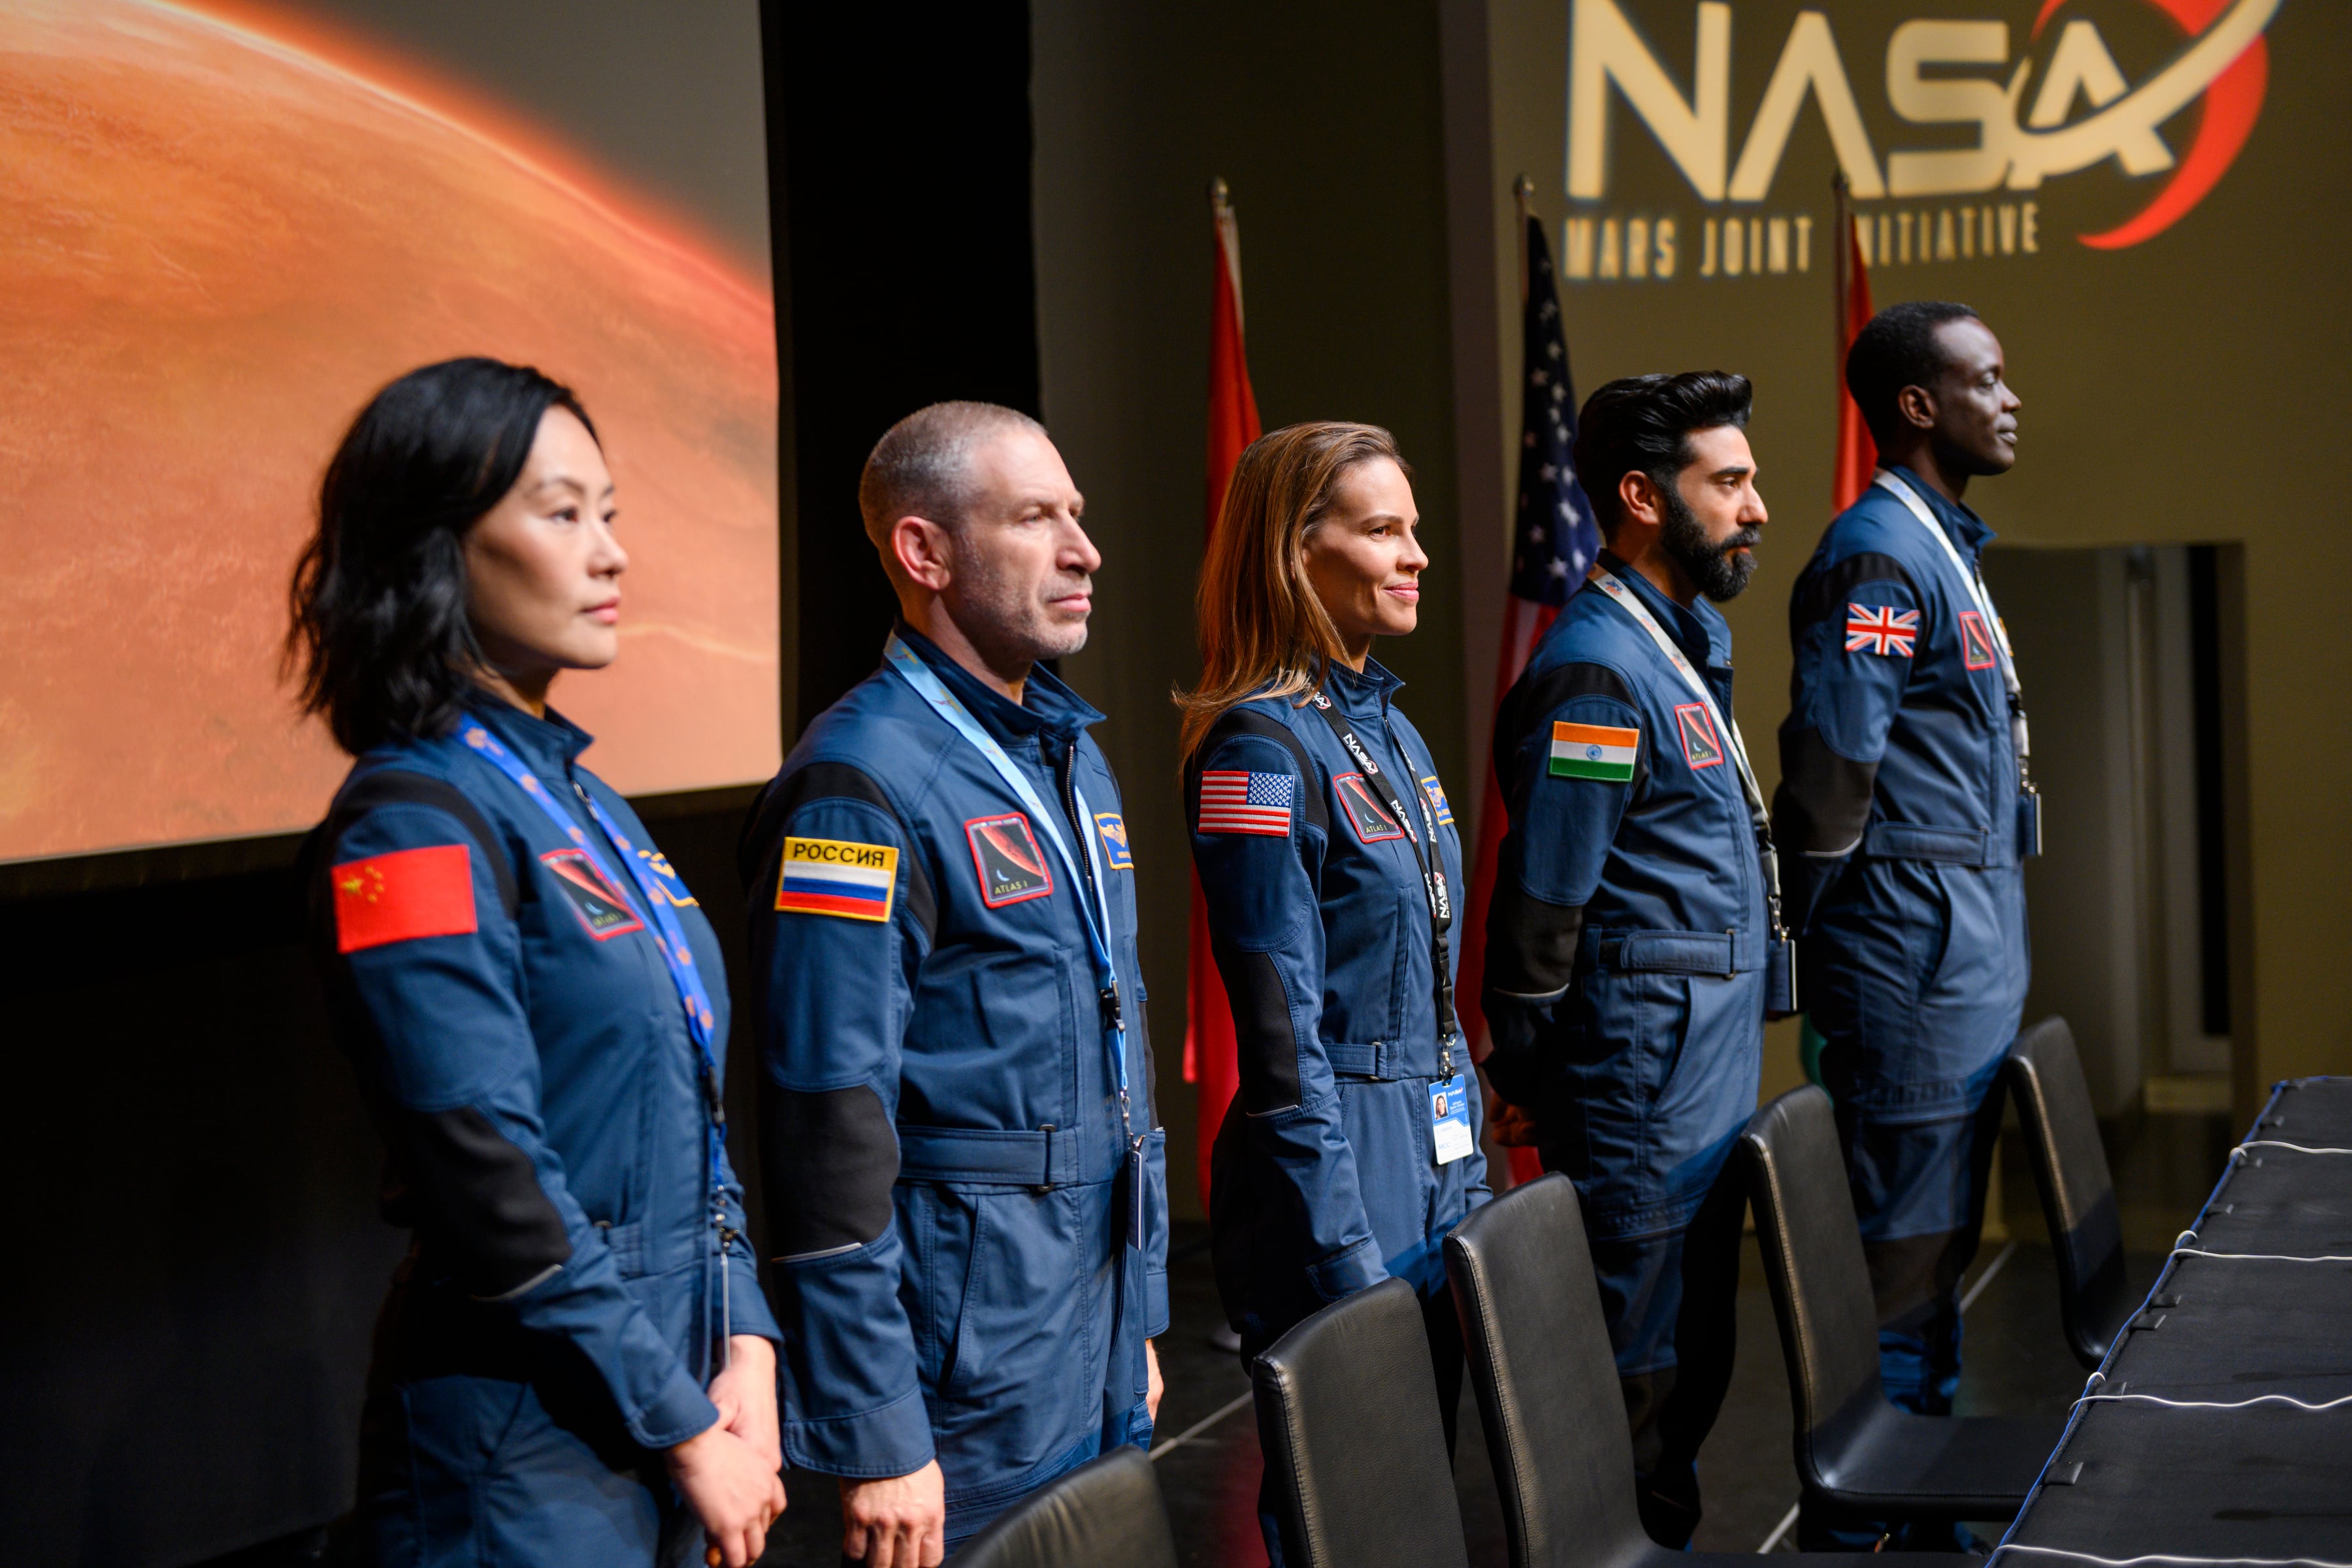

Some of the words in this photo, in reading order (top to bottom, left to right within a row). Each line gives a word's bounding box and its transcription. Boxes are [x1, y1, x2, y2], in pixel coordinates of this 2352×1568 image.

[1566, 0, 2177, 201] NASA
[1563, 217, 1677, 279] MARS
[1700, 216, 1812, 276] JOINT
[1854, 201, 2040, 268] NITIATIVE
[1345, 733, 1378, 773] NASA
[1365, 825, 1383, 834] ATLAS
[794, 843, 884, 866] РОССИЯ
[994, 881, 1022, 895] ATLAS
[1434, 872, 1448, 919] NASA
[1448, 1087, 1463, 1097] NASA
